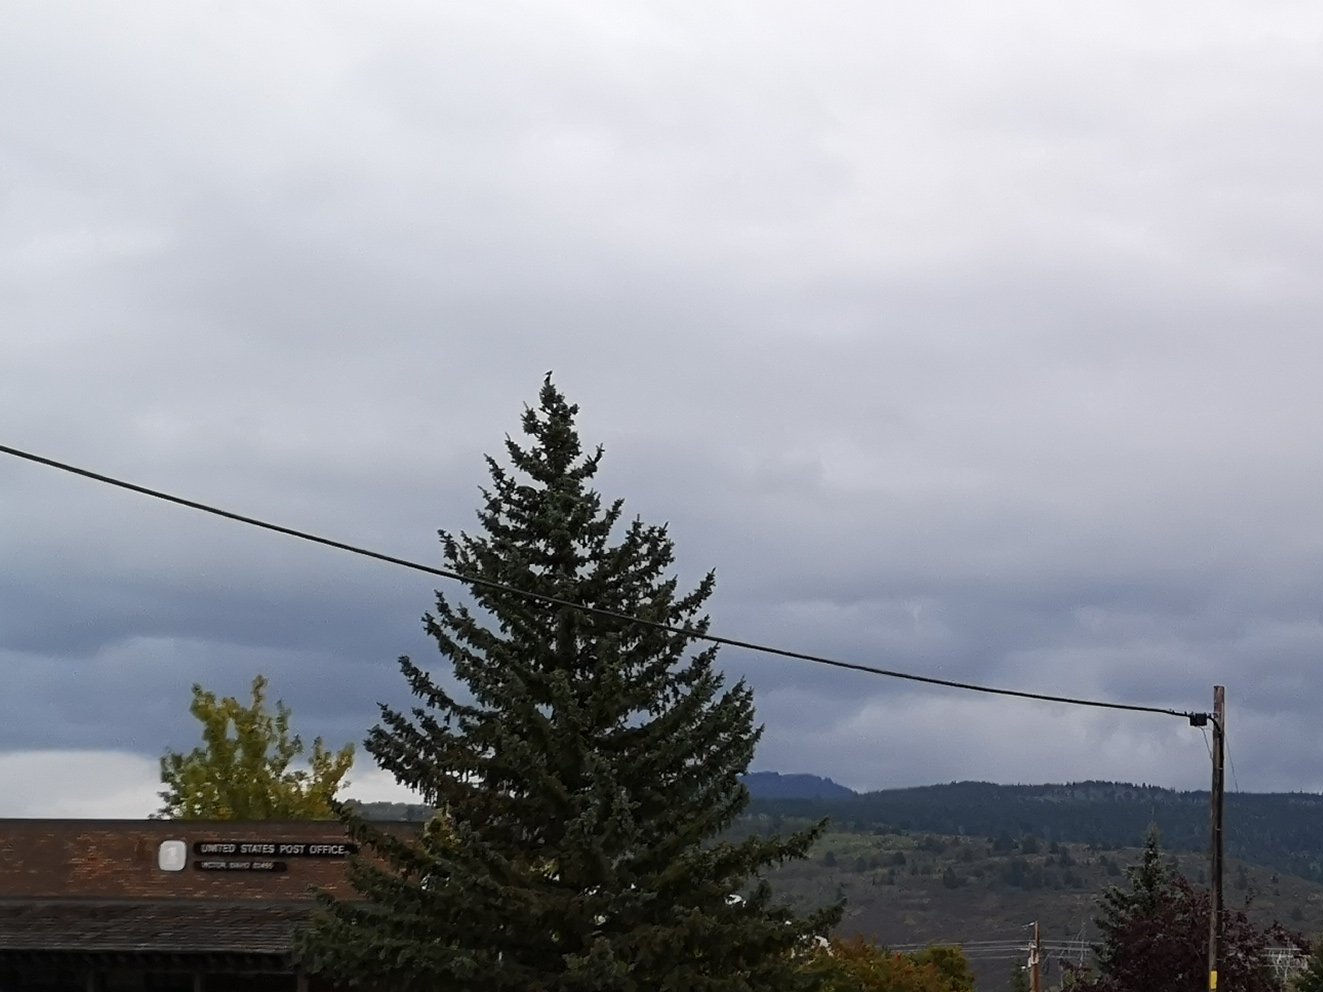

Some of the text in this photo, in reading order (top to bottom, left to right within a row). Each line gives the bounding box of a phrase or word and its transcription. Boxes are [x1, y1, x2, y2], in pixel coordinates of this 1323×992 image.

[201, 843, 345, 855] UNITED STATES POST OFFICE
